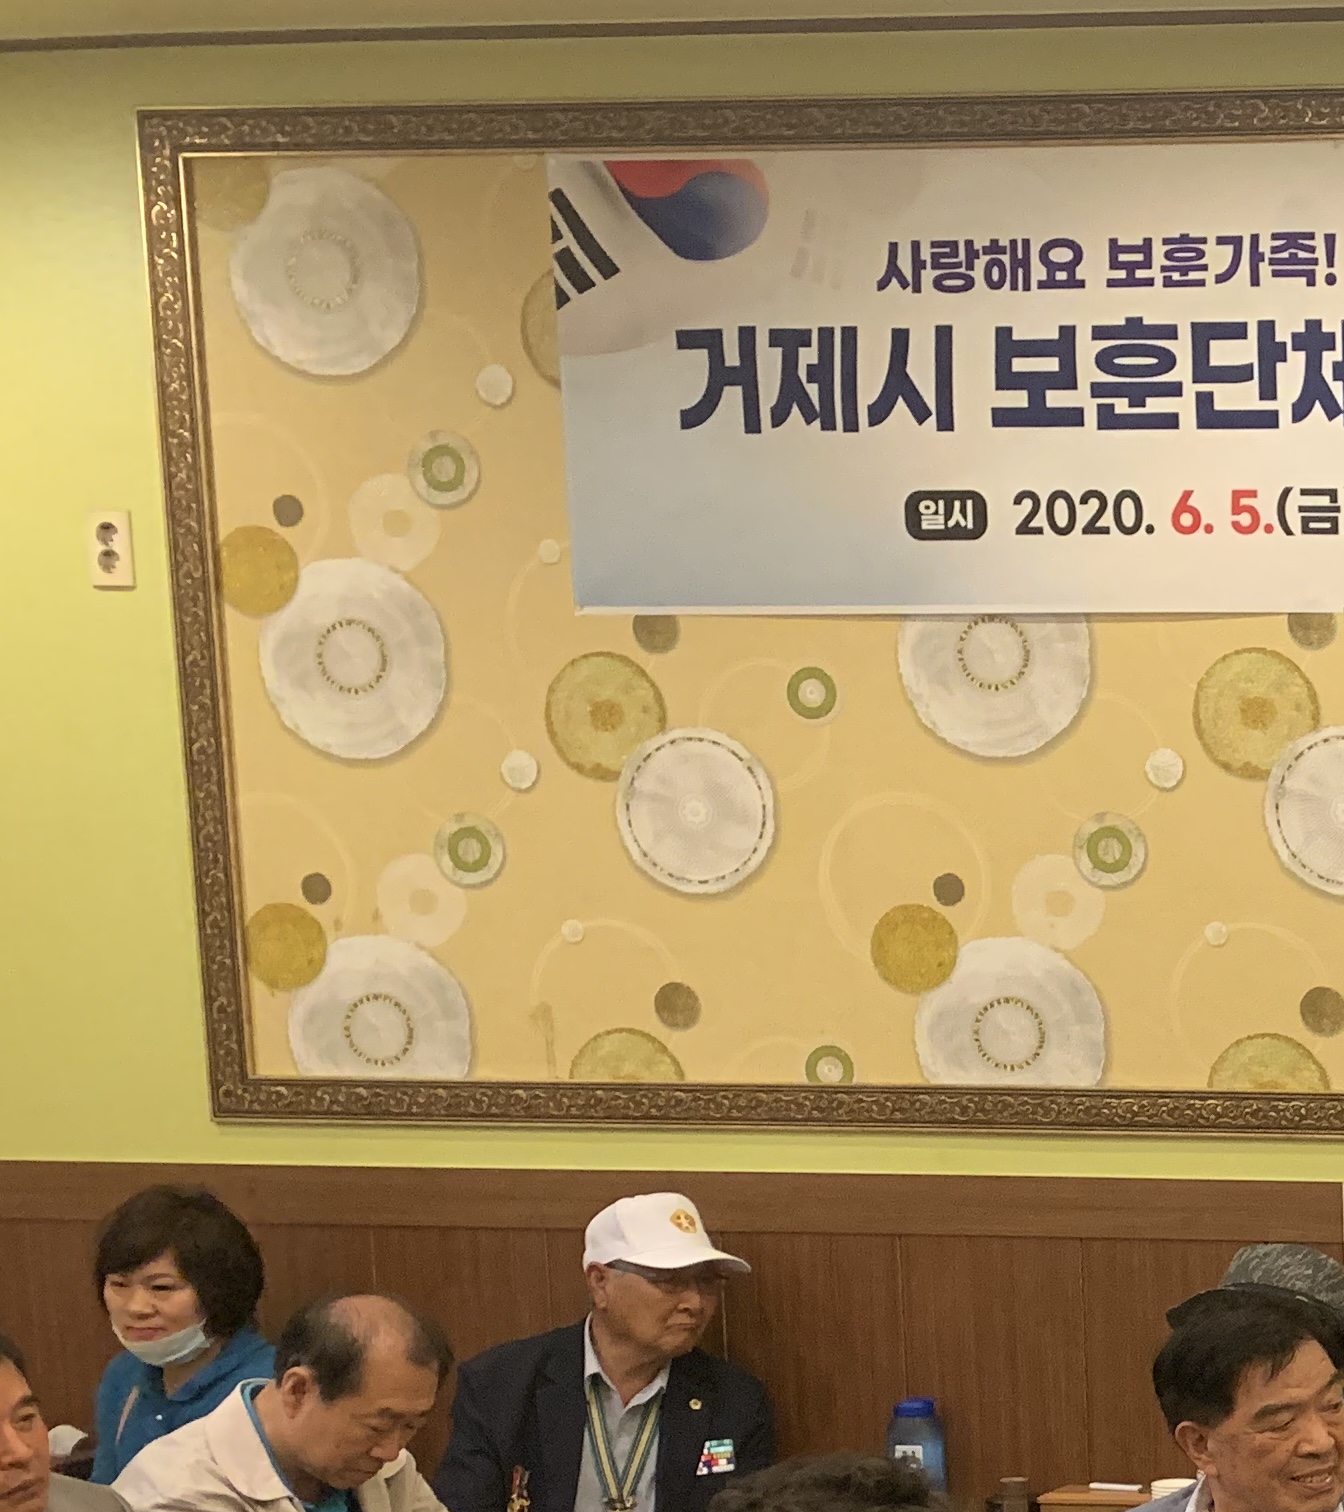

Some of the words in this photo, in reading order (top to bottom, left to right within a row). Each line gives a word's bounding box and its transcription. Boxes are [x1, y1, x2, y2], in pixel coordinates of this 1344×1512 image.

[877, 238, 1085, 293] 사랑해요
[1106, 232, 1337, 288] 보훈가족!
[675, 325, 954, 434] 거제시
[917, 499, 975, 531] 일시
[1013, 490, 1155, 536] 2020.
[1172, 490, 1213, 535] 6.
